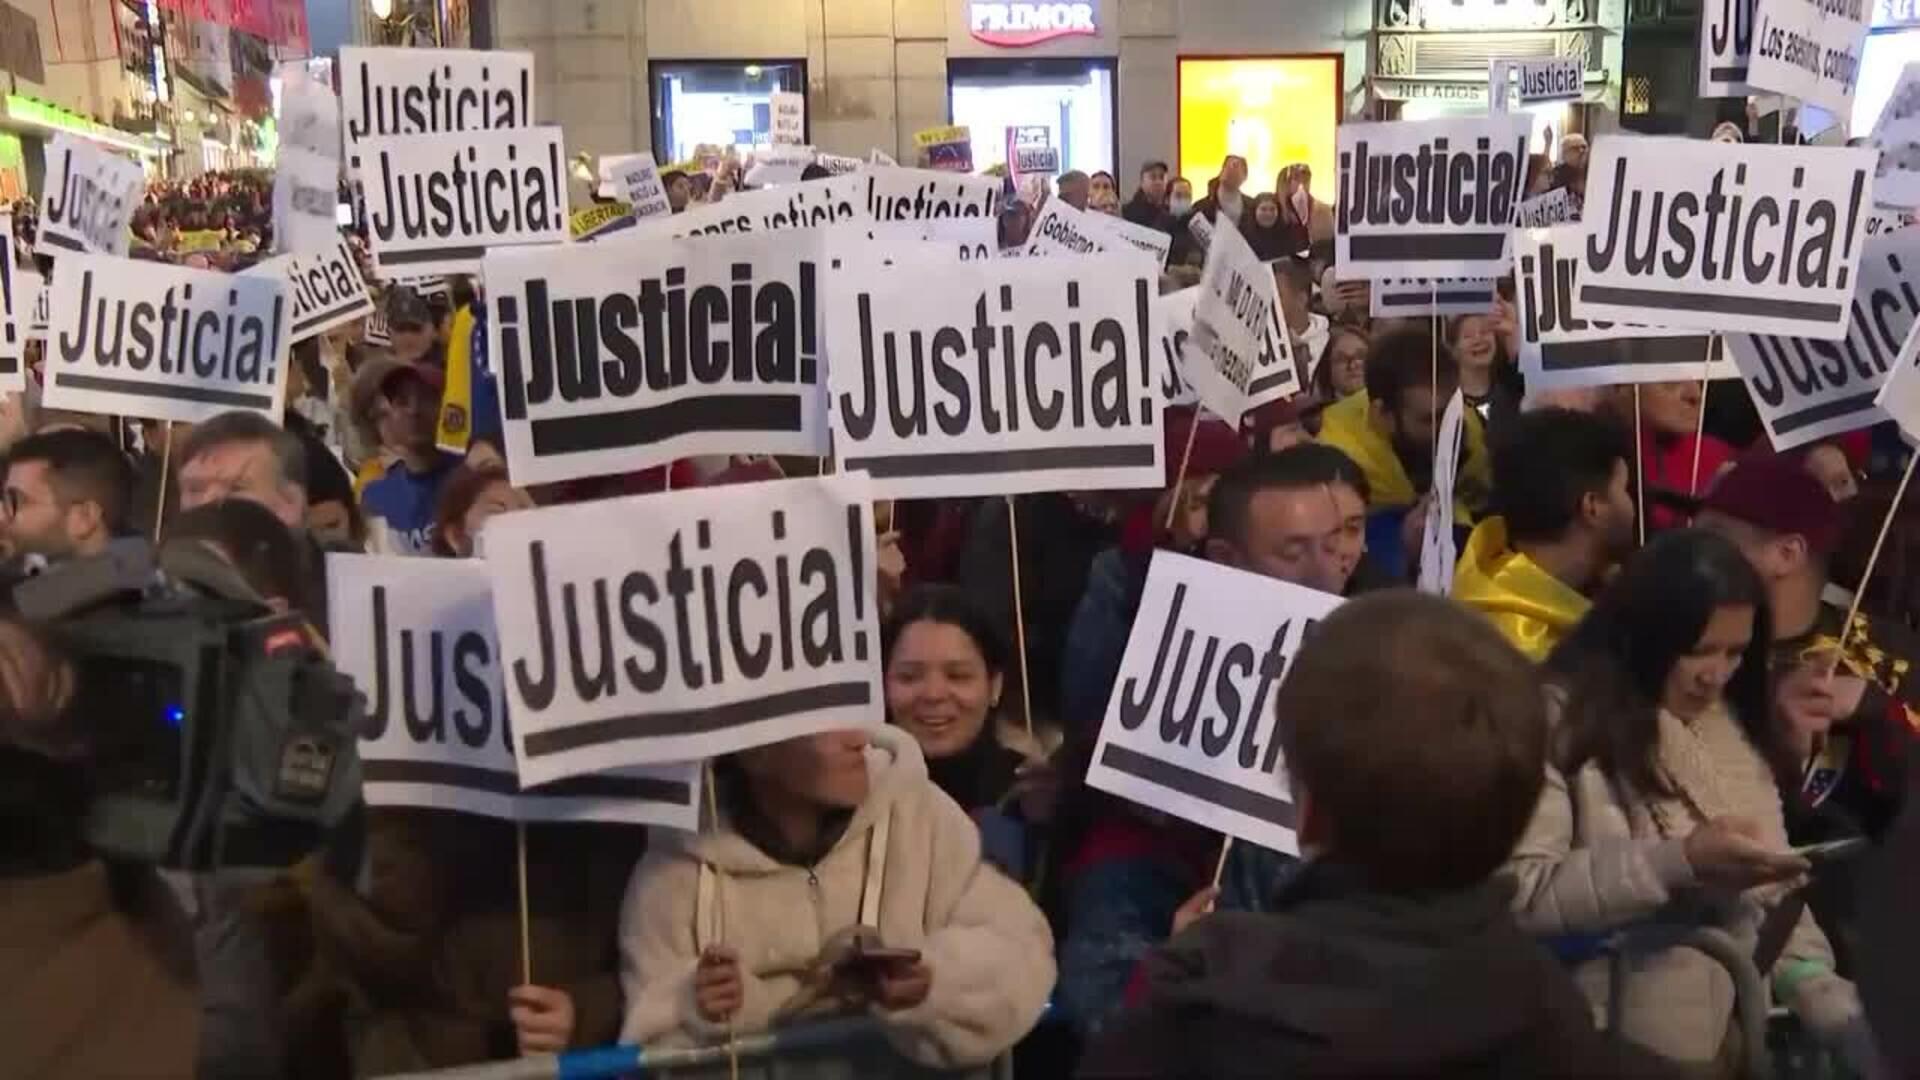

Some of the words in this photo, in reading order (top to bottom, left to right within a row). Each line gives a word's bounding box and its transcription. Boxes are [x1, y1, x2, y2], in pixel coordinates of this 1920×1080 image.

[971, 3, 1095, 32] PRIMOR
[1399, 84, 1480, 99] HELADOS
[1520, 57, 1582, 96] Justicia!
[372, 142, 562, 242] Justicia!
[1338, 136, 1526, 235] ¡Justicia!
[1586, 157, 1866, 290] Justicia!
[59, 271, 284, 384] Justicia!
[497, 262, 817, 420] ¡Justicia!
[840, 279, 1153, 441] Justicia!
[512, 504, 869, 712] Justicia!
